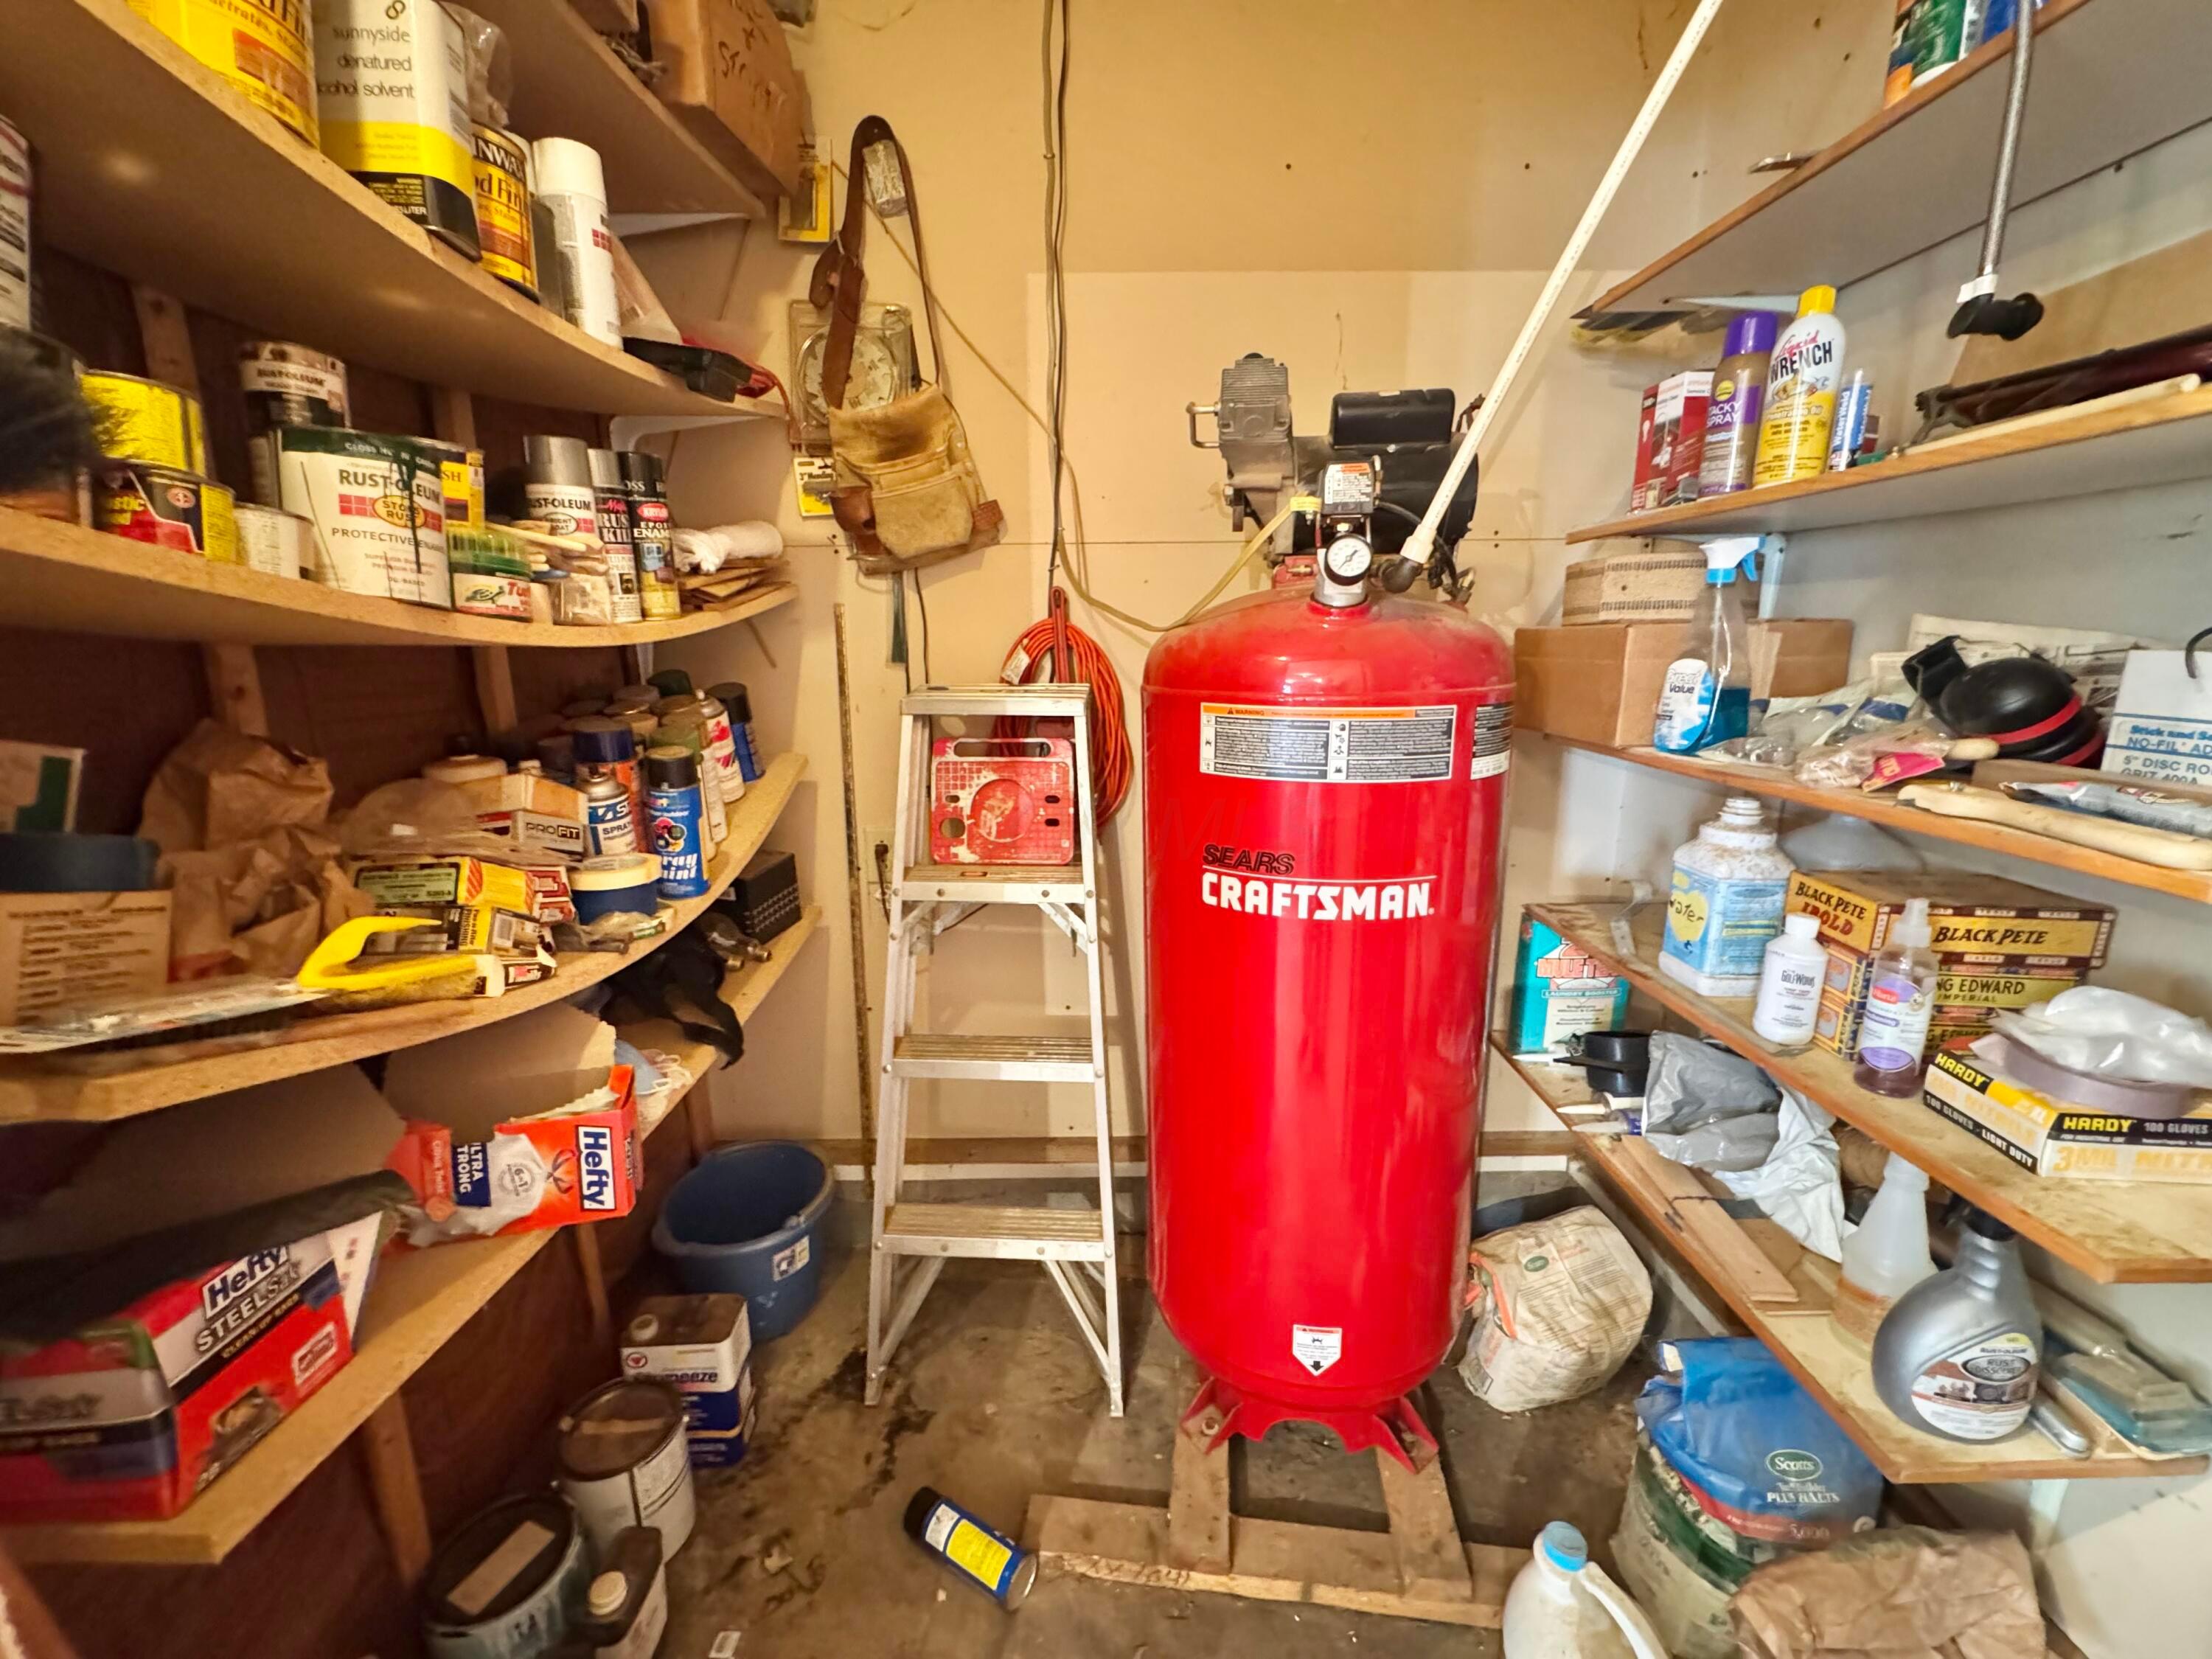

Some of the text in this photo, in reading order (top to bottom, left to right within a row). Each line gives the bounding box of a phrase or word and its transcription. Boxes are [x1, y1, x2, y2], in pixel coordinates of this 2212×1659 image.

[333, 26, 411, 46] sunnyside
[337, 55, 412, 72] denatured
[363, 81, 415, 98] solvent
[478, 138, 526, 181] NWAX
[1775, 330, 1820, 359] Liquid
[1770, 341, 1833, 383] WRENCH
[1708, 400, 1742, 416] TACKY
[1708, 413, 1740, 428] SPRAY
[532, 497, 591, 511] ST-OLEUM
[597, 514, 629, 528] RUS
[332, 528, 417, 546] PROTECTIVE
[633, 529, 671, 538] ENAM
[1669, 684, 1695, 694] Value
[2142, 758, 2181, 771] DISC
[662, 853, 697, 868] ray
[1203, 844, 1295, 874] SEARS
[1202, 872, 1431, 921] CRAFTSMAN
[1795, 881, 1867, 920] BLACK PETE
[1933, 926, 2049, 945] BLACK PETE
[1936, 978, 2025, 995] NG EDWARD
[1934, 1052, 1987, 1088] HARDY
[1925, 1094, 1942, 1110] 100
[1943, 1105, 1974, 1130] GLOVES
[1981, 1128, 2007, 1150] LIGHT
[2008, 1145, 2033, 1167] DUTY
[2063, 1116, 2208, 1134] HARDY 100 GLOVES
[456, 1147, 473, 1194] TRONG
[581, 1130, 609, 1207] Hefty
[208, 1247, 281, 1312] Hefty
[1775, 1456, 1815, 1471] Scotts
